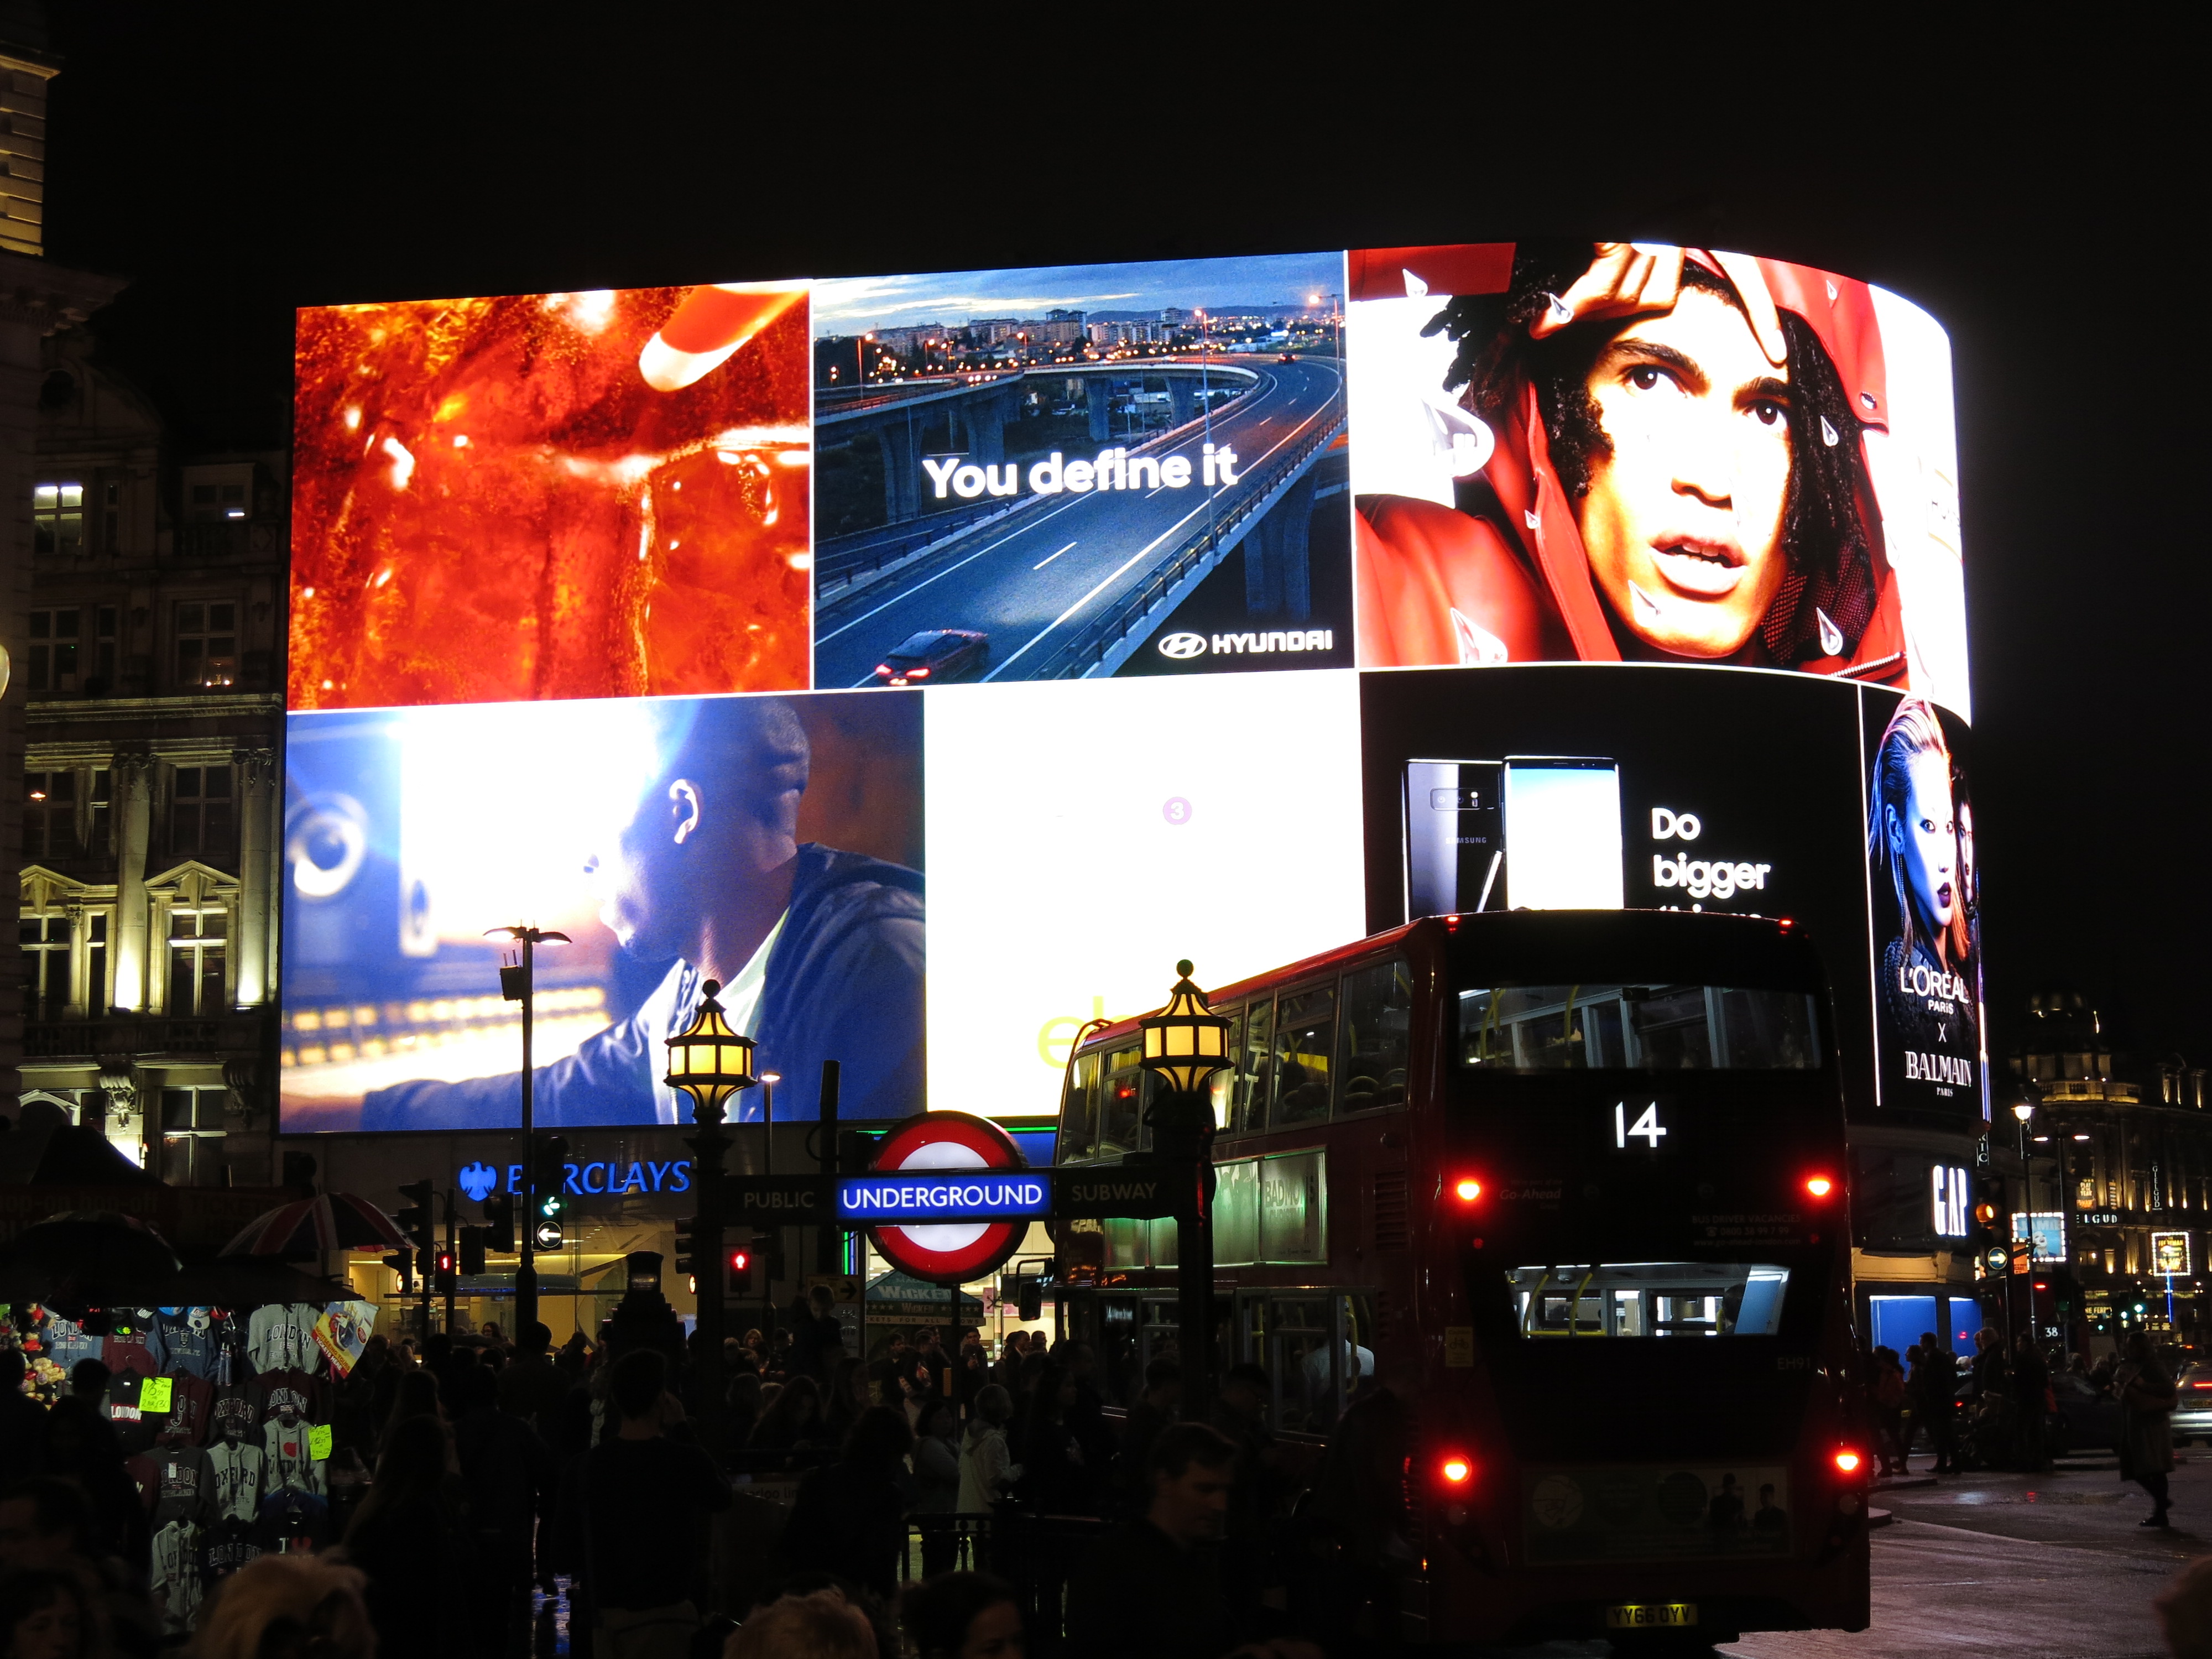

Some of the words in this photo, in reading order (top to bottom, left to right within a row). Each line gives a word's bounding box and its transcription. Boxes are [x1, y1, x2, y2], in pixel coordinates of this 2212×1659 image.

[924, 458, 1017, 498] You
[1030, 448, 1191, 493] define
[1203, 444, 1239, 486] it
[1212, 630, 1332, 654] HYUNDAI
[1652, 807, 1701, 841] Do
[1653, 852, 1771, 899] bigger
[1900, 966, 1969, 1004] L'ORÉAL
[1937, 1022, 1947, 1043] X
[1904, 1051, 1972, 1087] BALMAIN
[1936, 1087, 1954, 1098] PARIS
[1615, 1100, 1667, 1149] 14
[507, 1160, 691, 1194] BRCLAYS
[744, 1191, 815, 1209] PUBLIC
[842, 1183, 1043, 1209] UNDERGROUND
[1071, 1182, 1157, 1202] SUBWAY
[1499, 1188, 1562, 1199] Go-Ahead
[1933, 1165, 1968, 1237] GAP
[1692, 1215, 1710, 1224] BUS
[1712, 1215, 1745, 1224] DRIVER
[1748, 1214, 1801, 1223] VACANCIES
[2044, 1326, 2059, 1338] 38
[315, 1326, 338, 1355] SIGHTSEEING
[338, 1354, 351, 1371] TOURS
[316, 1336, 332, 1358] TICKETS
[330, 1355, 342, 1371] HERE
[1778, 1357, 1811, 1370] EH91
[111, 1406, 143, 1420] LONDON
[1613, 1608, 1655, 1625] YY66
